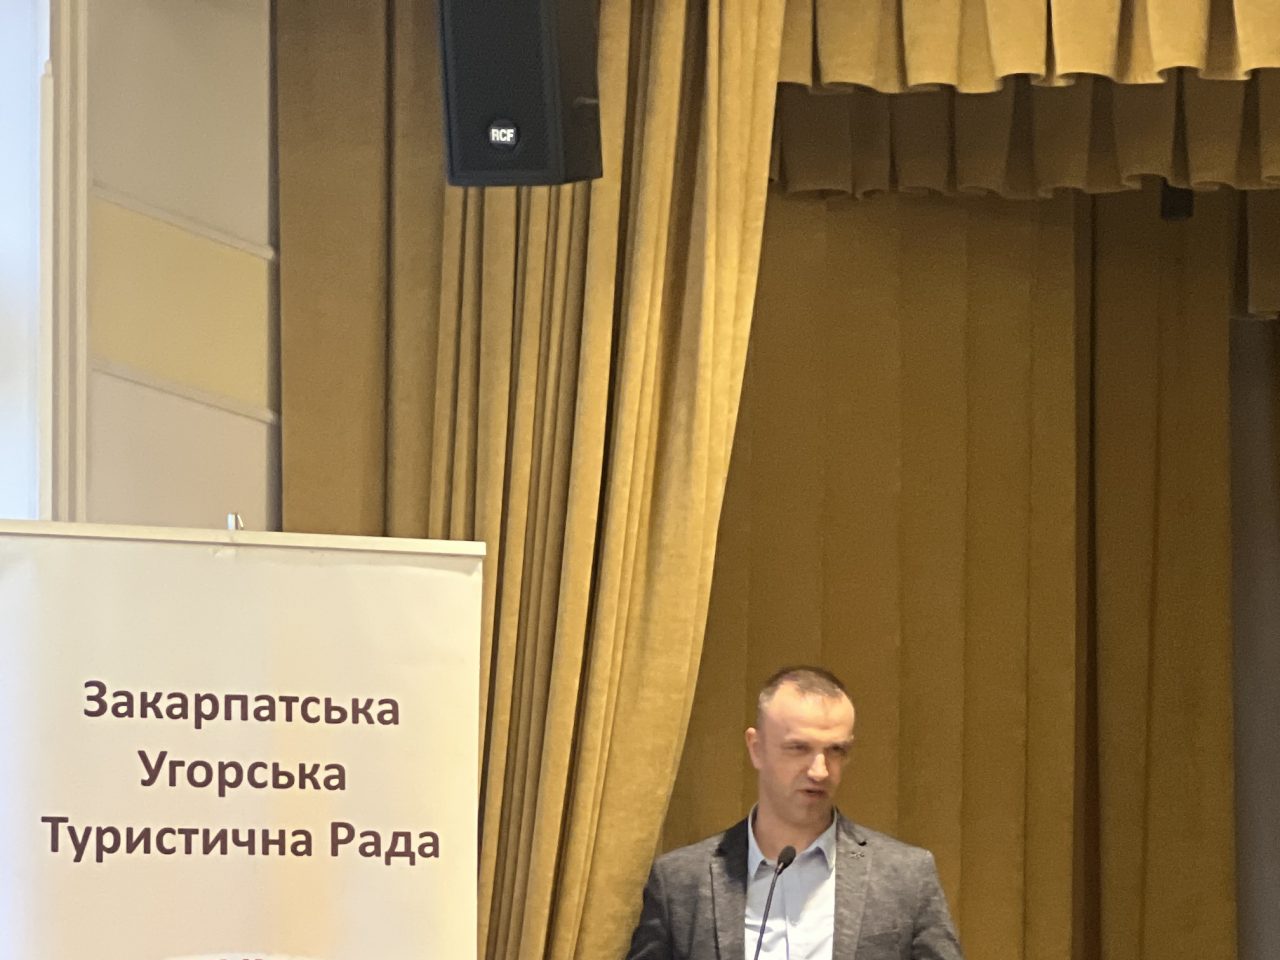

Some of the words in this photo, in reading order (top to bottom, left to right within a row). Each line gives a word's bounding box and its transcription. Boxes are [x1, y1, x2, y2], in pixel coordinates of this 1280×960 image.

[490, 128, 515, 142] RCF
[83, 679, 400, 729] Закарпатська
[137, 750, 347, 797] Угорська
[41, 815, 313, 863] Туристична
[329, 821, 440, 866] Рада
